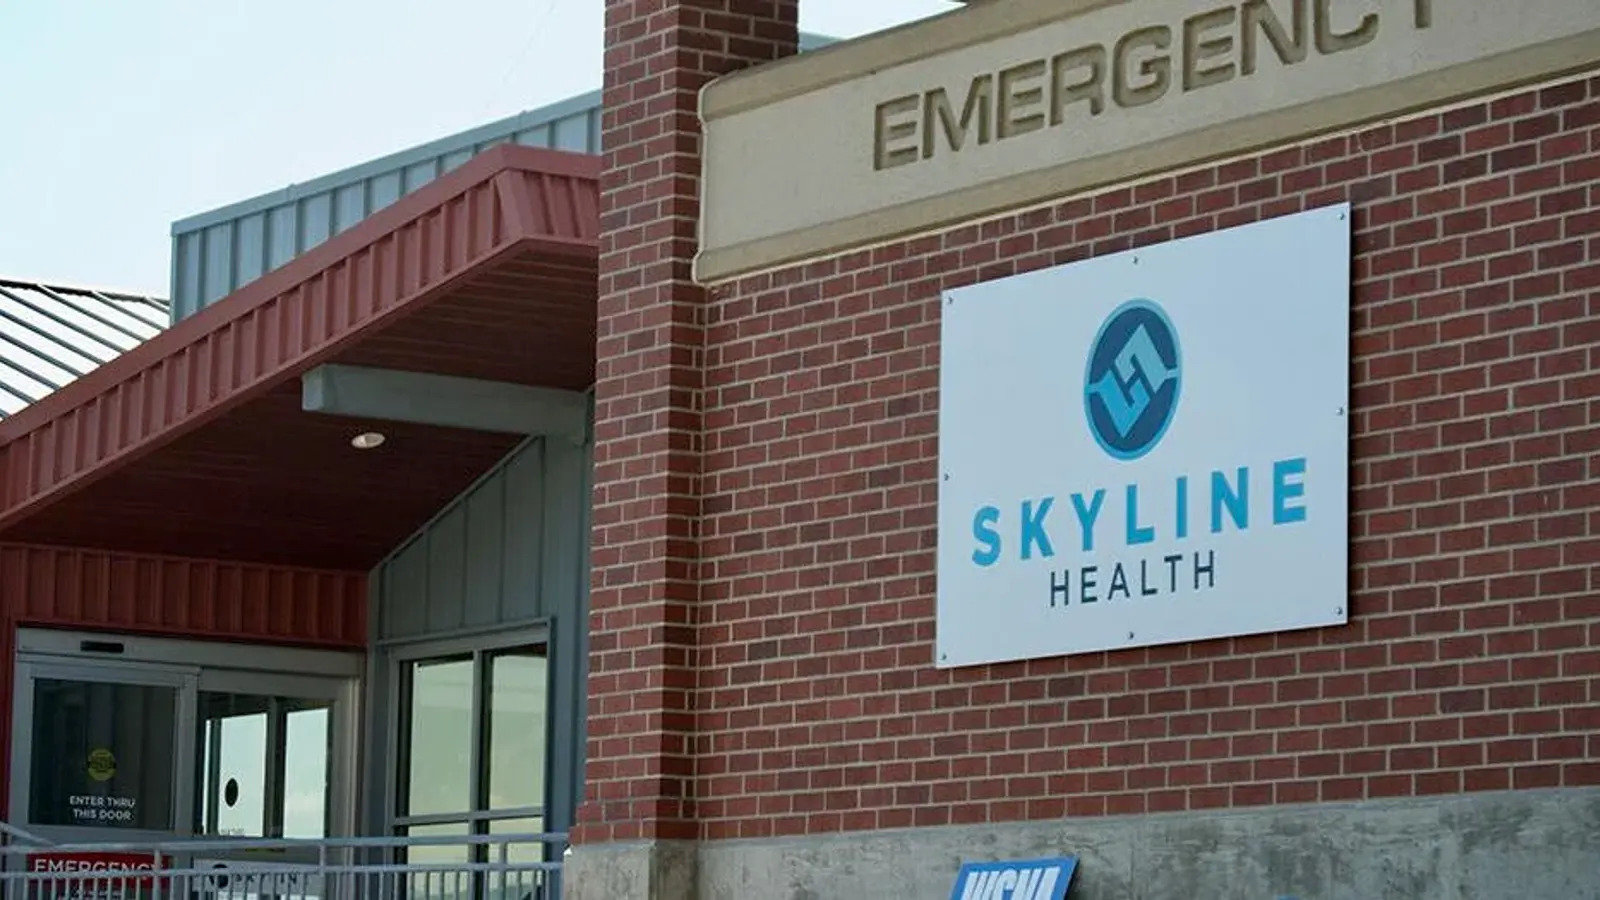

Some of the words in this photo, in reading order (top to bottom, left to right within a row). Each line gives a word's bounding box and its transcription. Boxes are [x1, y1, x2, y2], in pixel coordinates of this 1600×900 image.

[971, 457, 1307, 567] SKYLINE
[1050, 549, 1215, 608] HEALTH
[69, 795, 104, 807] ENTER
[107, 796, 136, 809] THRU
[73, 808, 97, 819] THIS
[99, 809, 132, 821] DOOR
